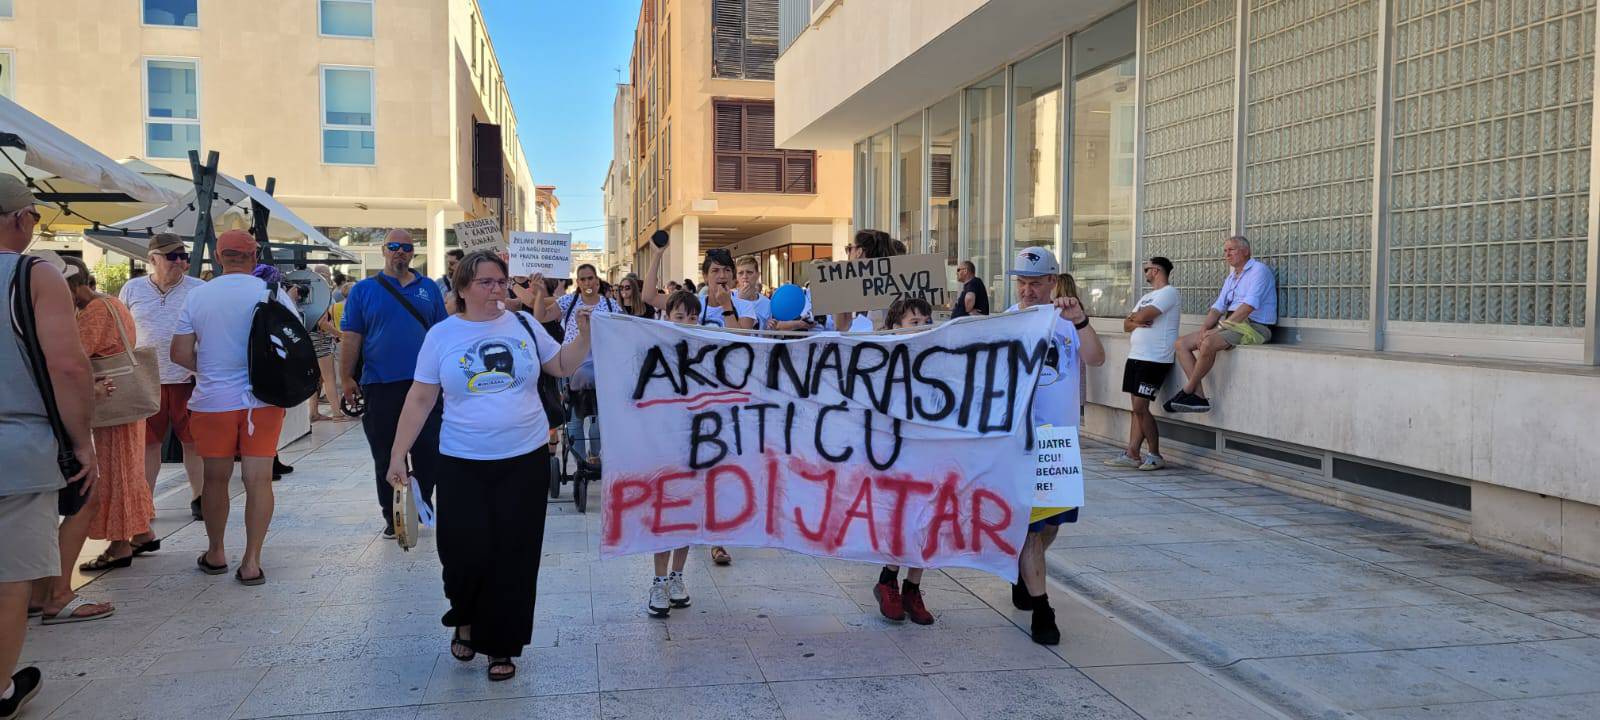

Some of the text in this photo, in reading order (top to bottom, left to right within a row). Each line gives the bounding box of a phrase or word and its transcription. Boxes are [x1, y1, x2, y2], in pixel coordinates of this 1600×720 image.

[463, 240, 468, 248] 3
[817, 257, 891, 283] IMAMO
[862, 270, 931, 297] PRAVO
[632, 336, 1049, 451] AKO NARASTEM
[688, 399, 903, 471] BITI ĆU
[1038, 438, 1072, 450] IJATRE
[1038, 453, 1061, 463] ECU!
[1035, 465, 1079, 477] BEĆANJA
[1036, 482, 1053, 491] RE!
[604, 459, 1019, 560] PEDIJATAR
